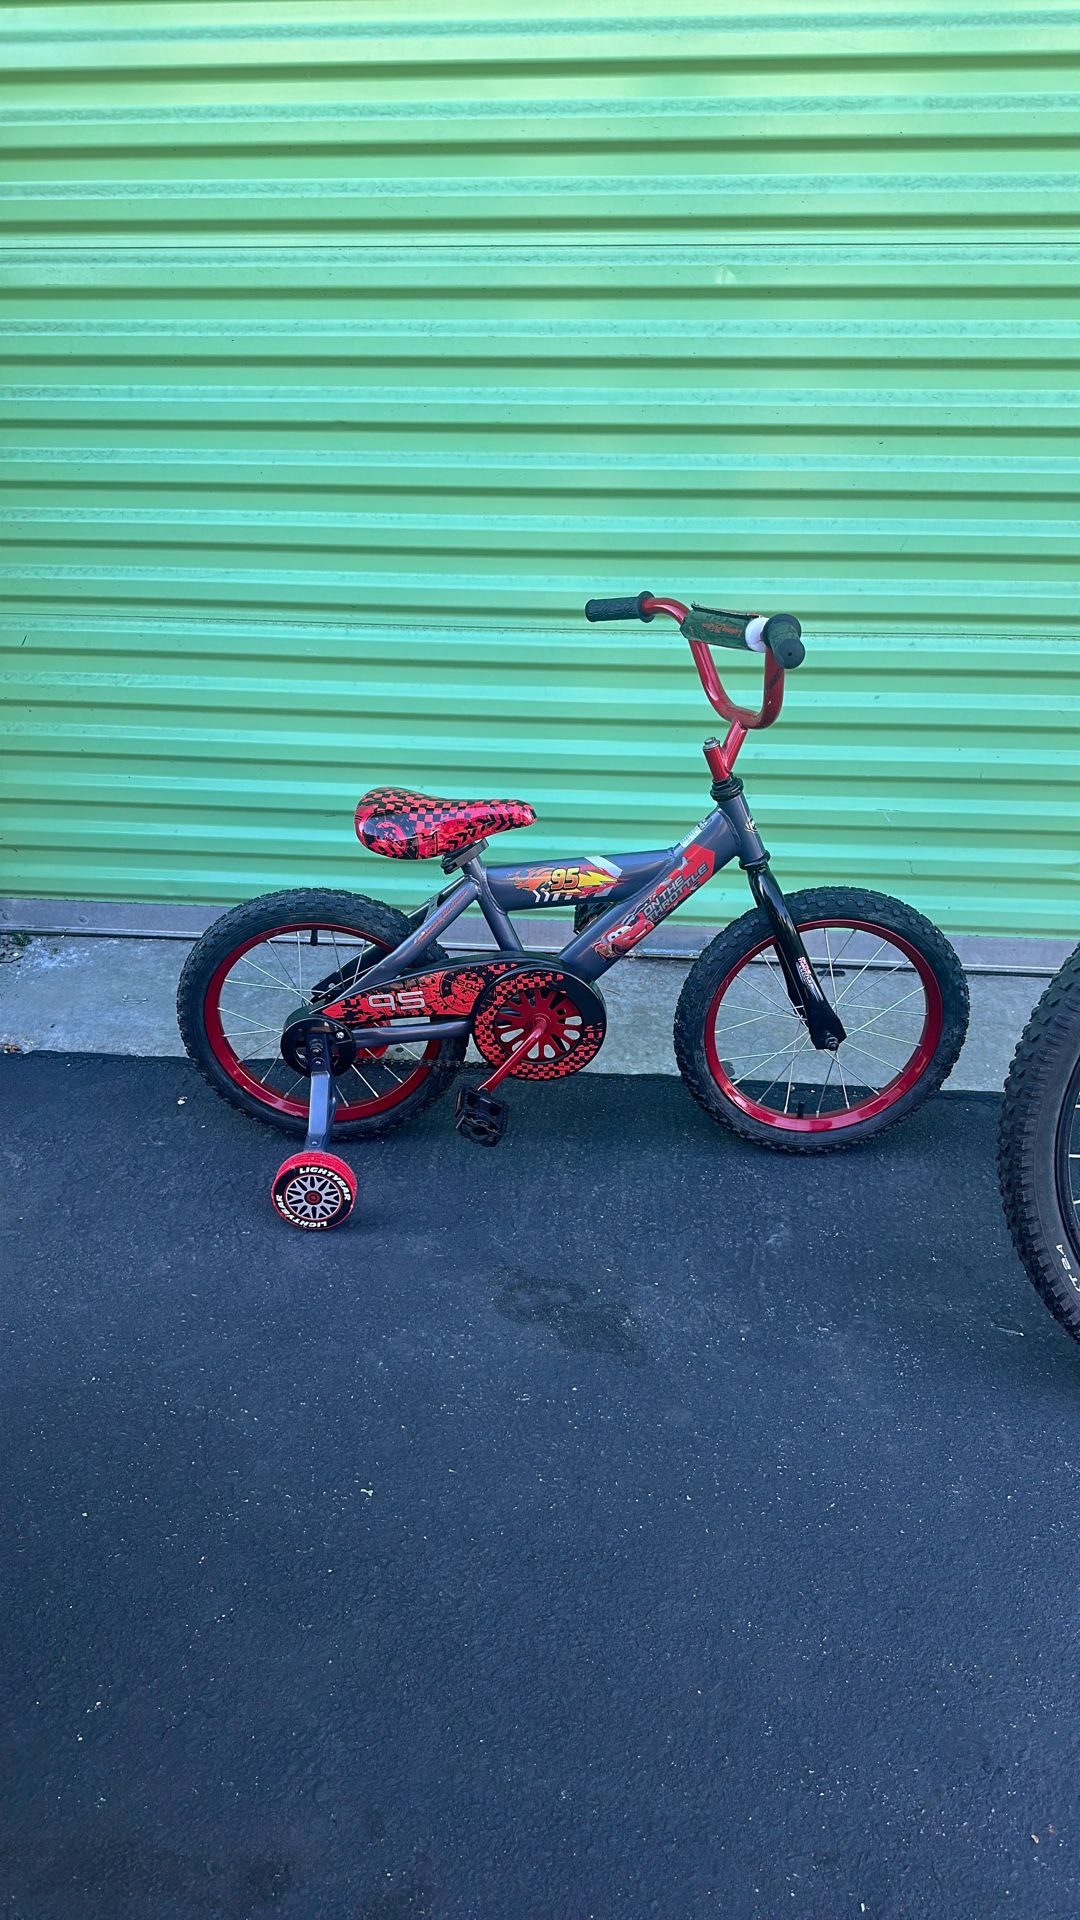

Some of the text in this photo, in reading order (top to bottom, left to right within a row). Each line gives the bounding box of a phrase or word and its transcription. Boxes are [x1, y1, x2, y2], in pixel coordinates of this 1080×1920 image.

[549, 867, 581, 892] 95
[643, 874, 685, 917] ON THE
[646, 863, 708, 923] THROTTLE
[368, 990, 426, 1011] 95
[299, 1167, 351, 1201] LIGHTYEAR
[276, 1194, 328, 1227] LIGHTYEAR
